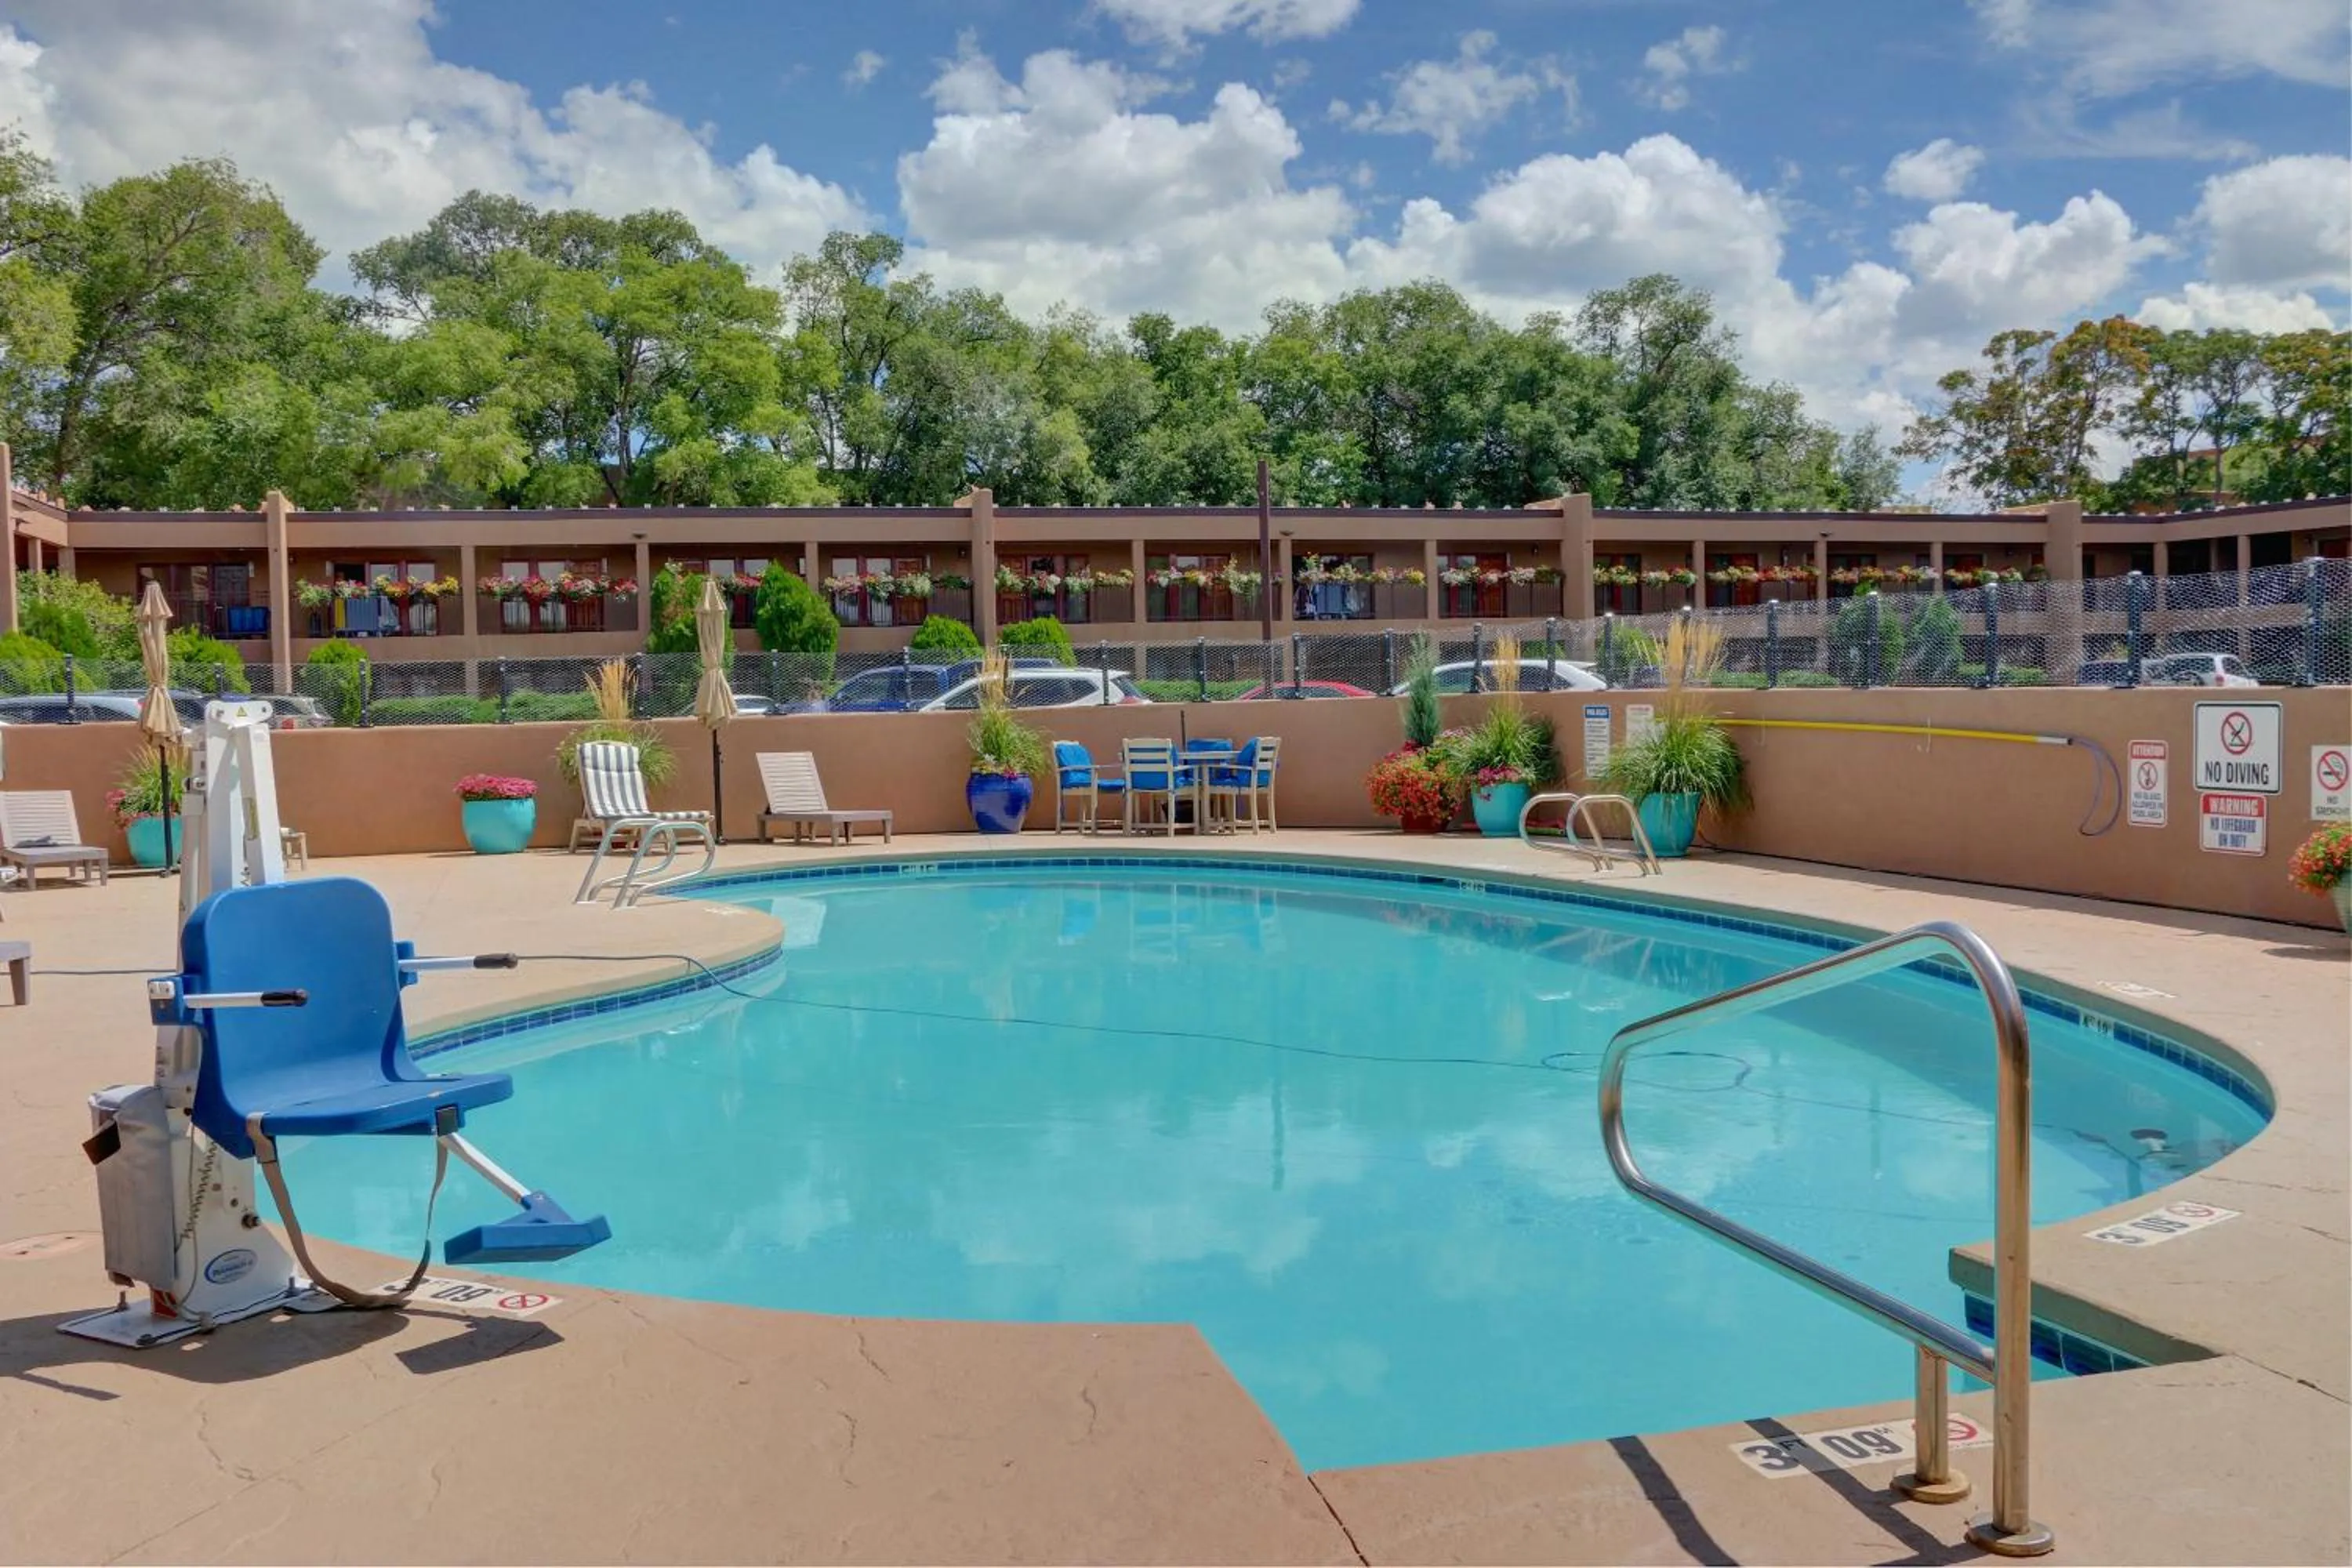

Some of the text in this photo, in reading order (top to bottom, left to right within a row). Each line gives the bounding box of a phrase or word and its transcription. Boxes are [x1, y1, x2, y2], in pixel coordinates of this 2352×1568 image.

[2205, 761, 2269, 785] NO DIVING
[2209, 797, 2258, 815] WARNING
[2210, 818, 2256, 833] NO LIFEGUARD
[2218, 833, 2247, 848] ON DUTY
